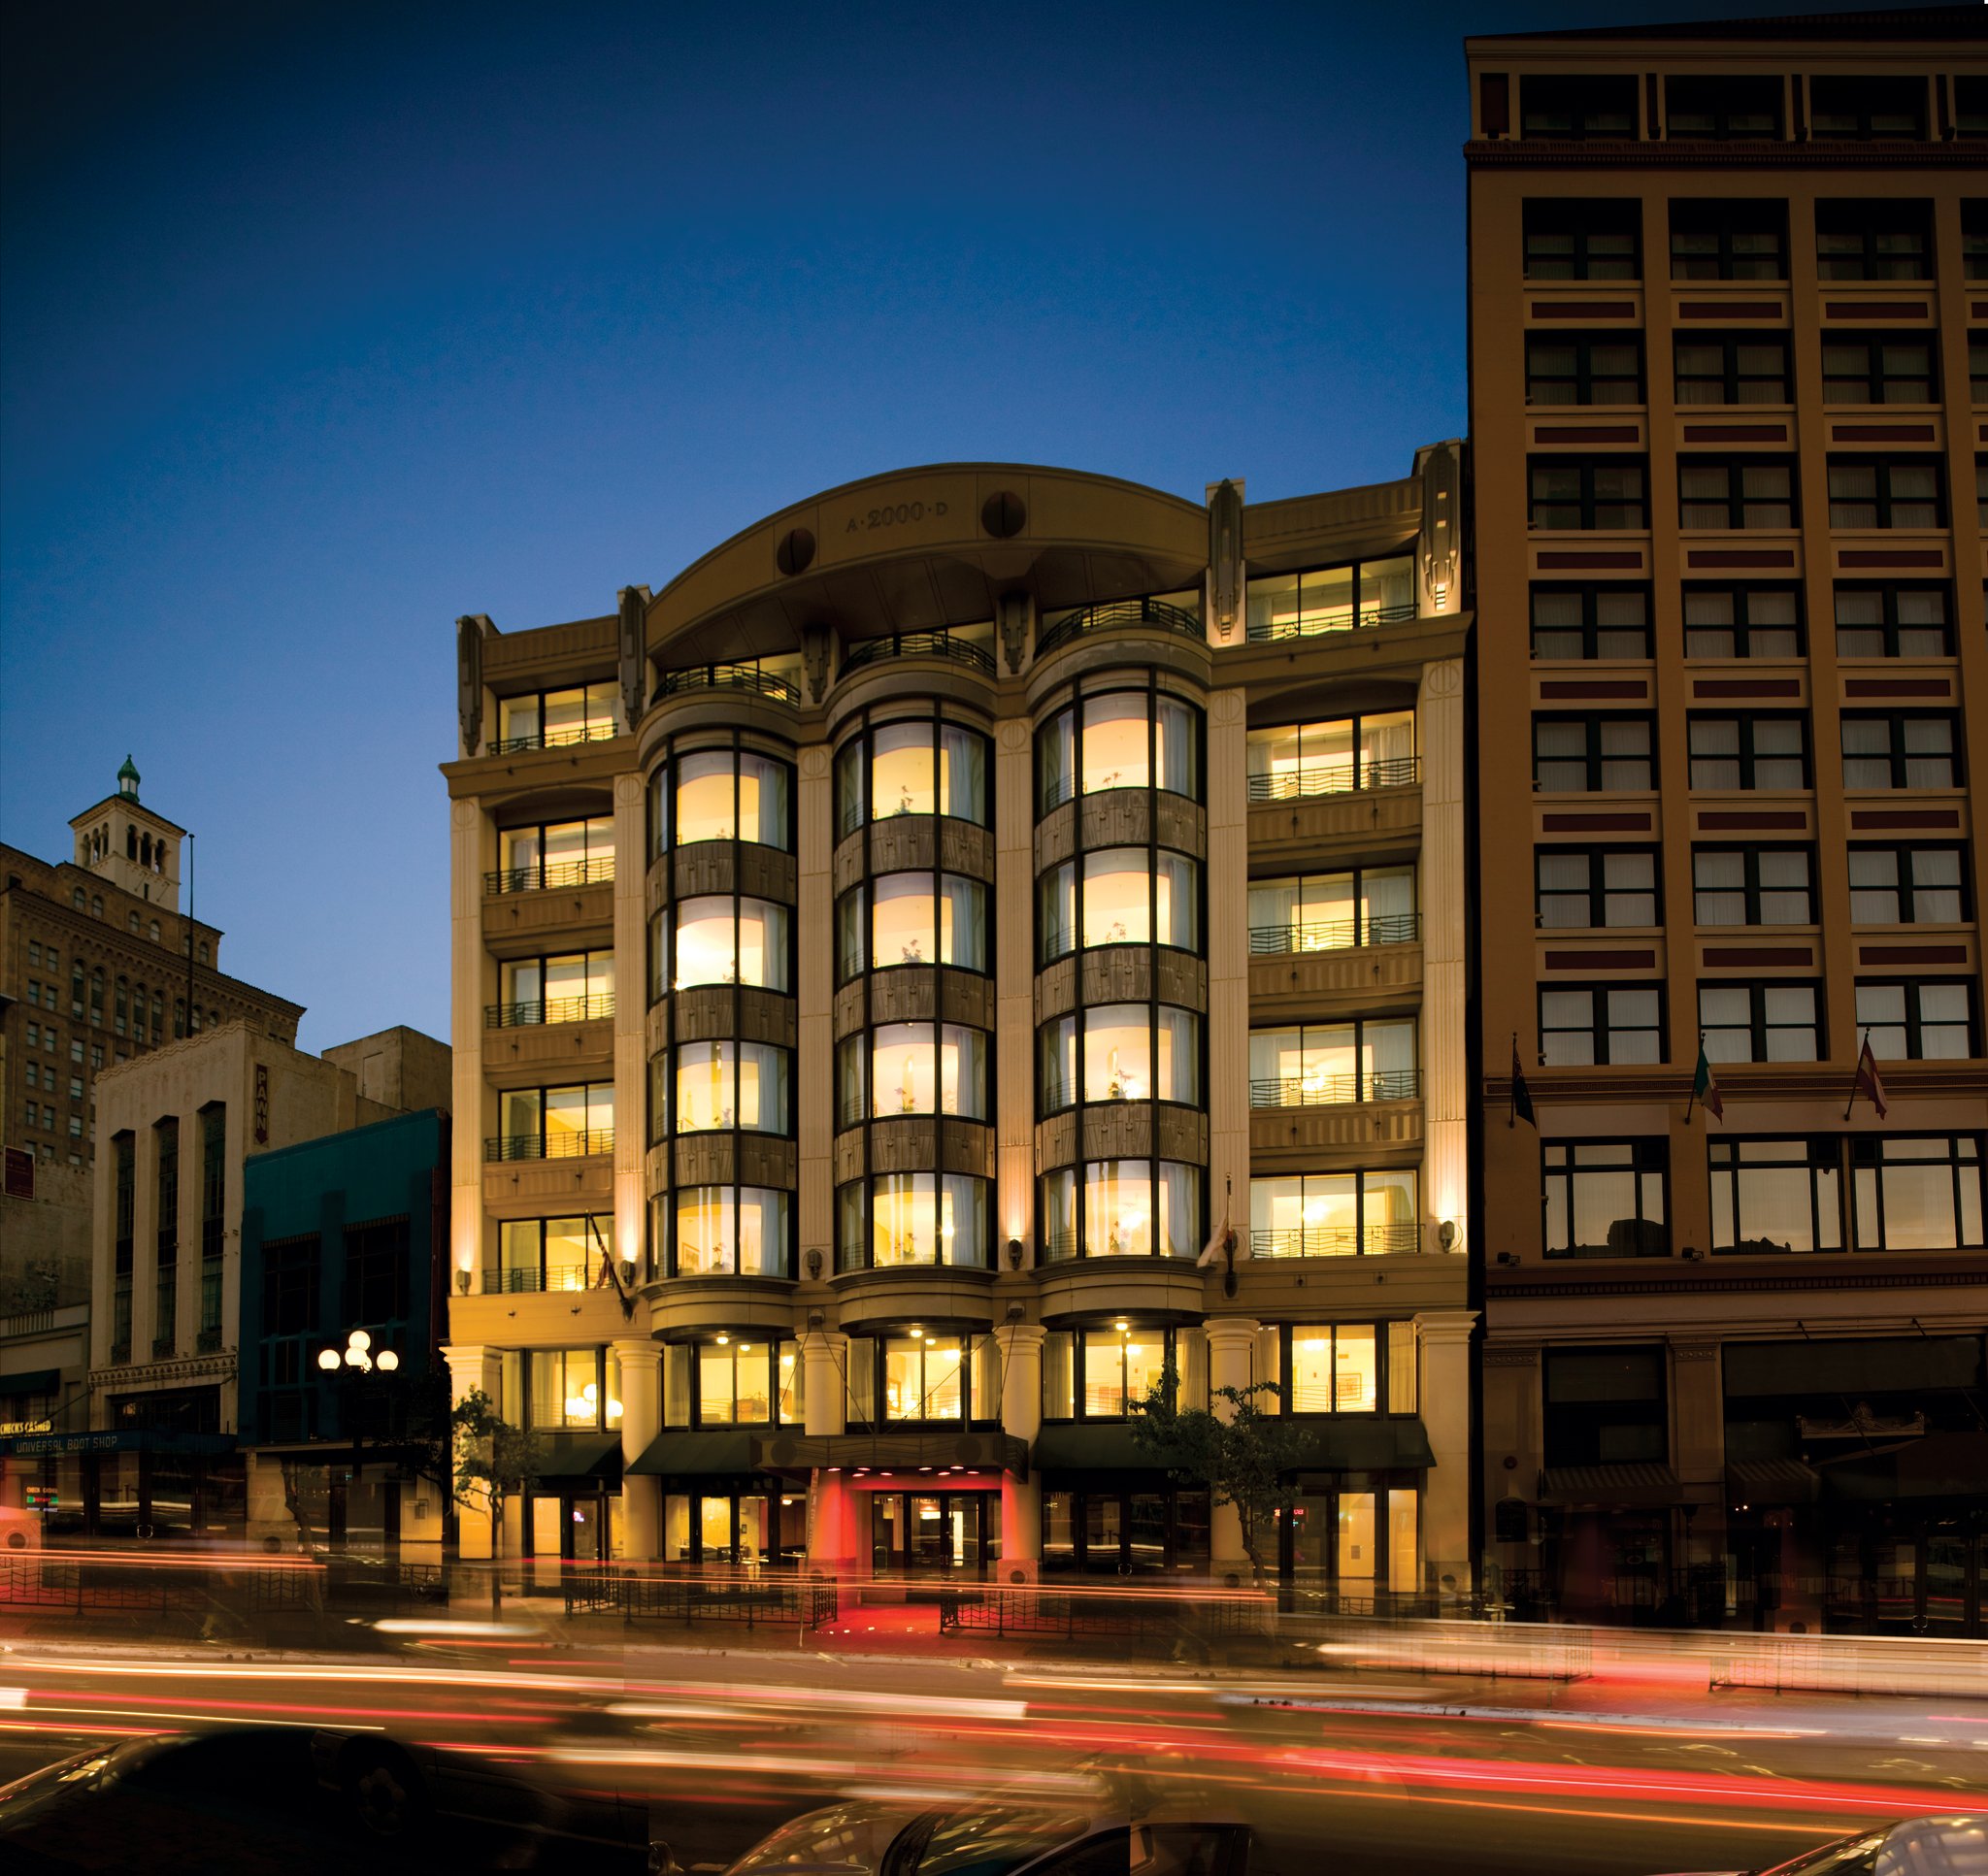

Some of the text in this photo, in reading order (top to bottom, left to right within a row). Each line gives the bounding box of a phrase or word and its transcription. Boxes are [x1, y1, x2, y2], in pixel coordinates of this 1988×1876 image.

[256, 1070, 267, 1130] PAWN
[24, 1420, 50, 1432] CASHED
[17, 1436, 116, 1453] UNIVERSAL BOOT SHOP
